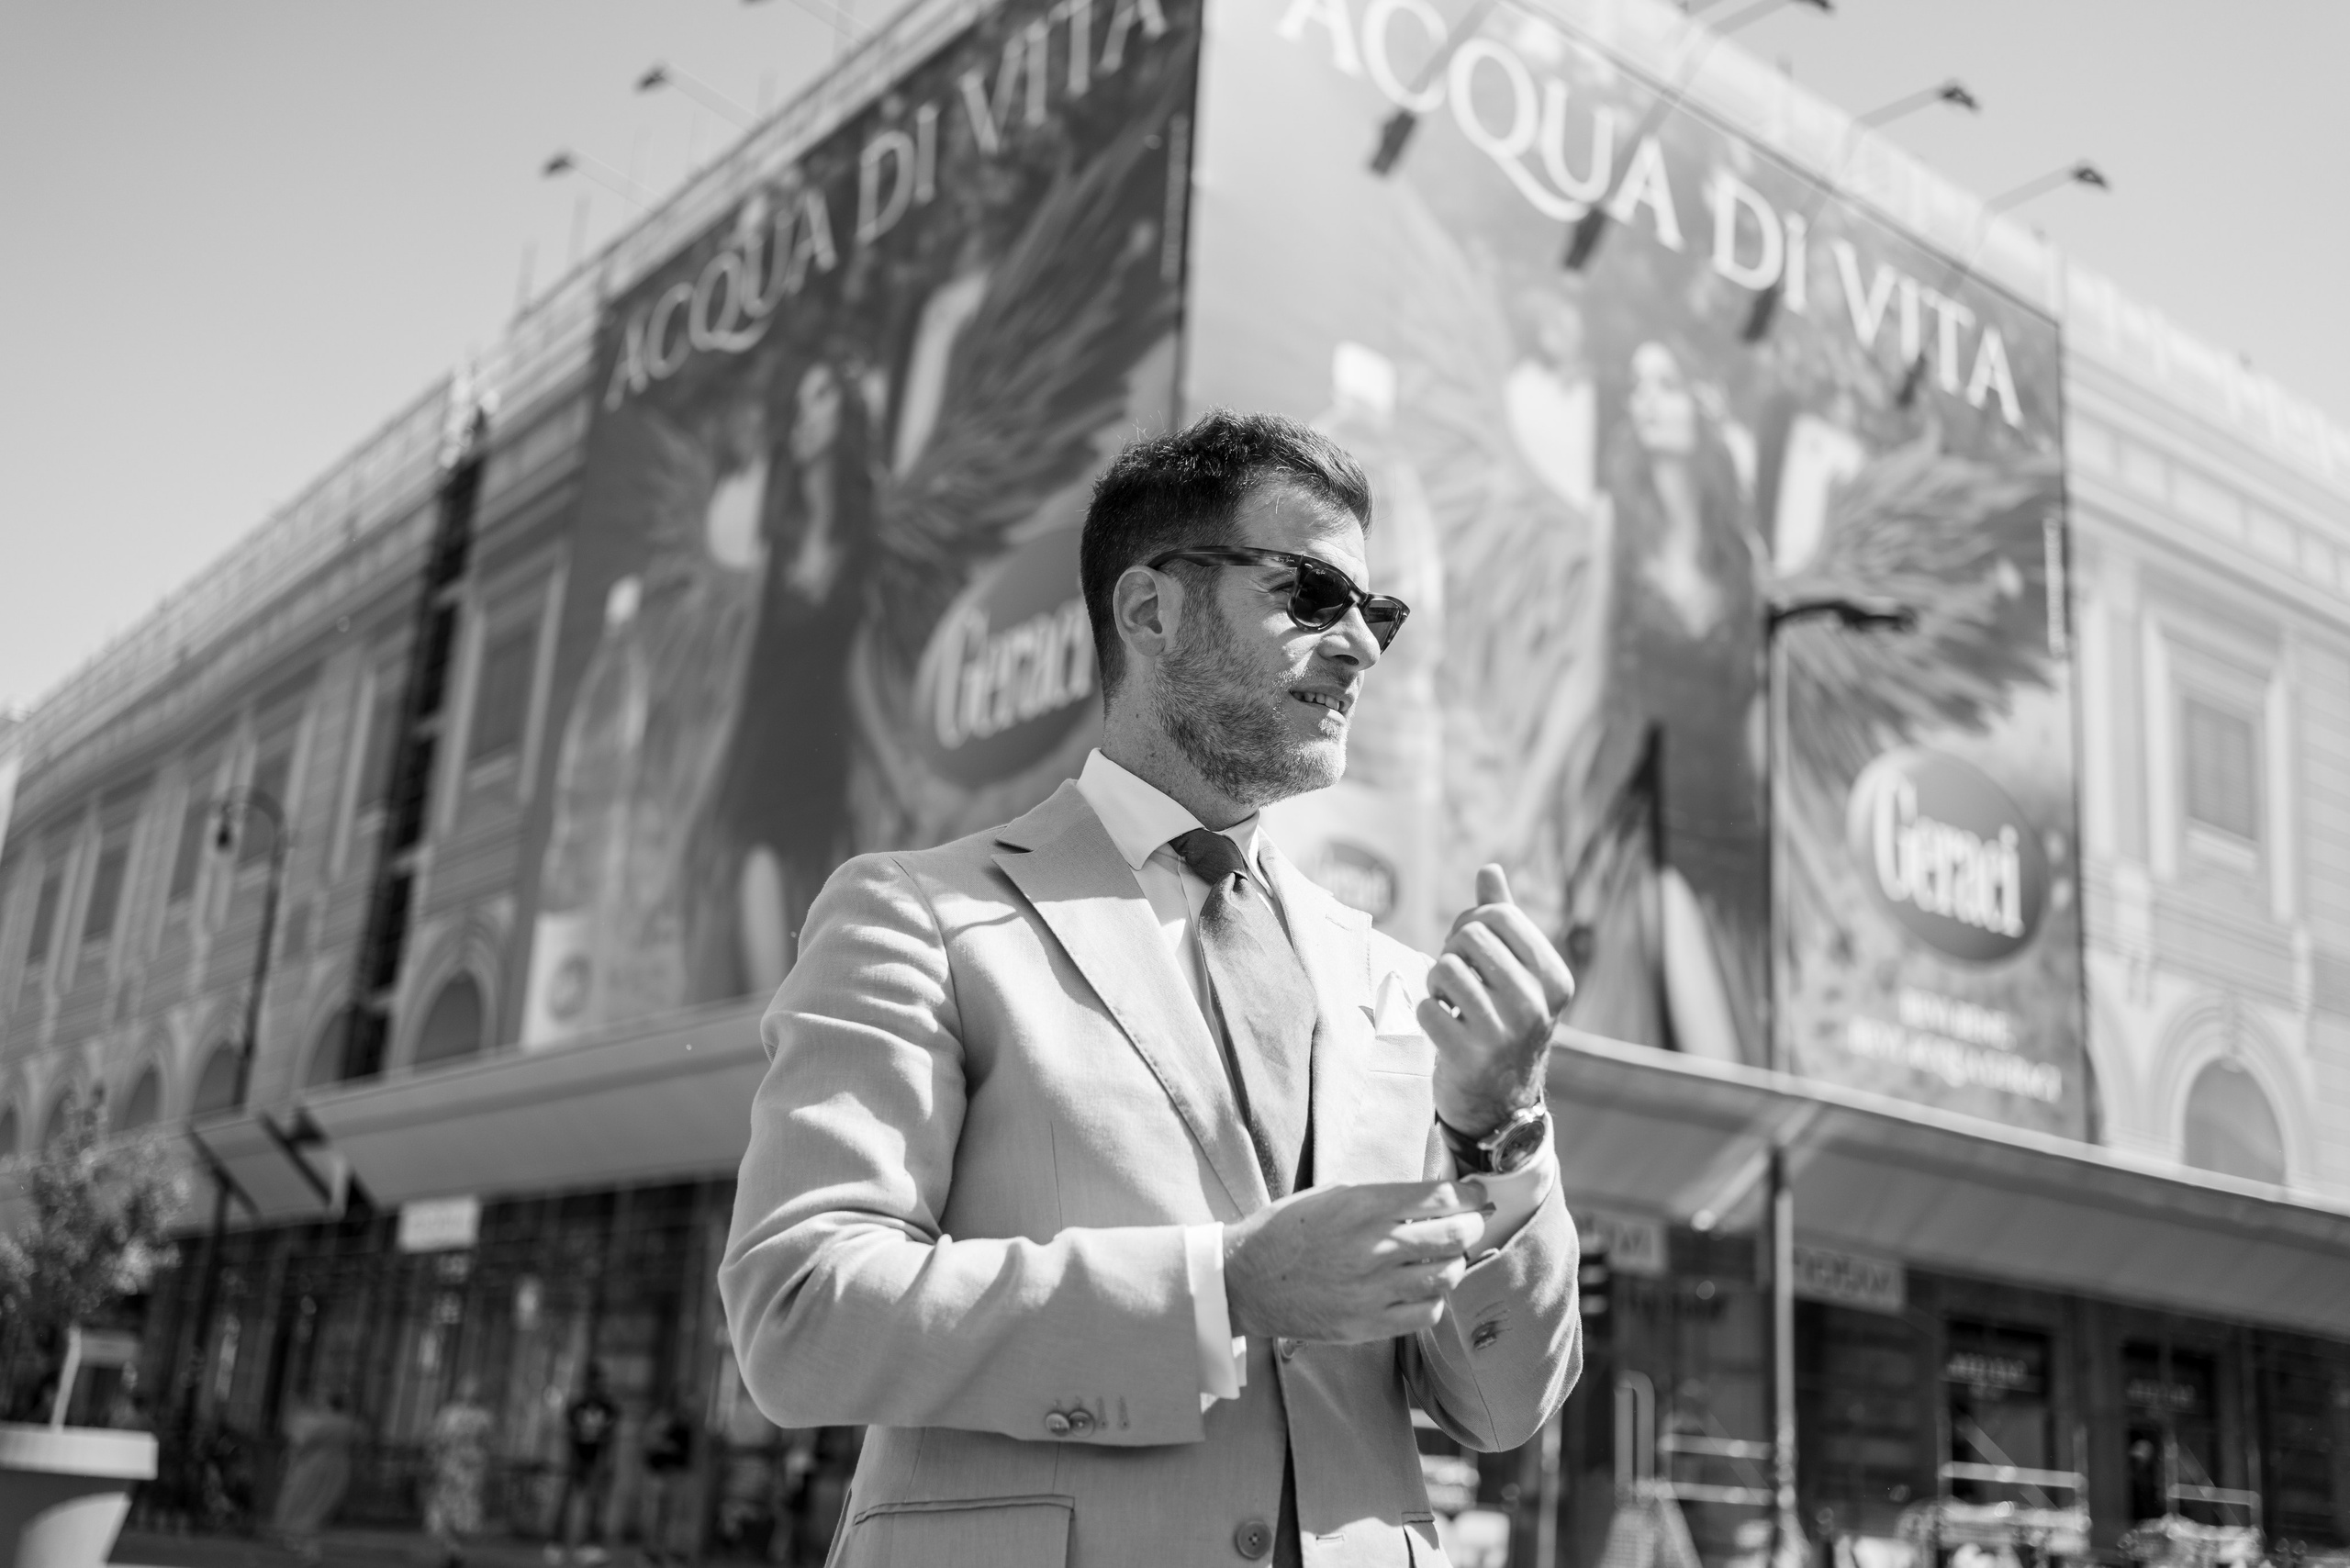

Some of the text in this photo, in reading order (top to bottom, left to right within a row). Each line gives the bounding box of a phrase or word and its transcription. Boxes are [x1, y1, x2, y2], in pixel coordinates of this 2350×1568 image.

[604, 187, 837, 410] ACQUA
[960, 0, 1166, 154] VITA
[1832, 239, 2024, 428] VITA
